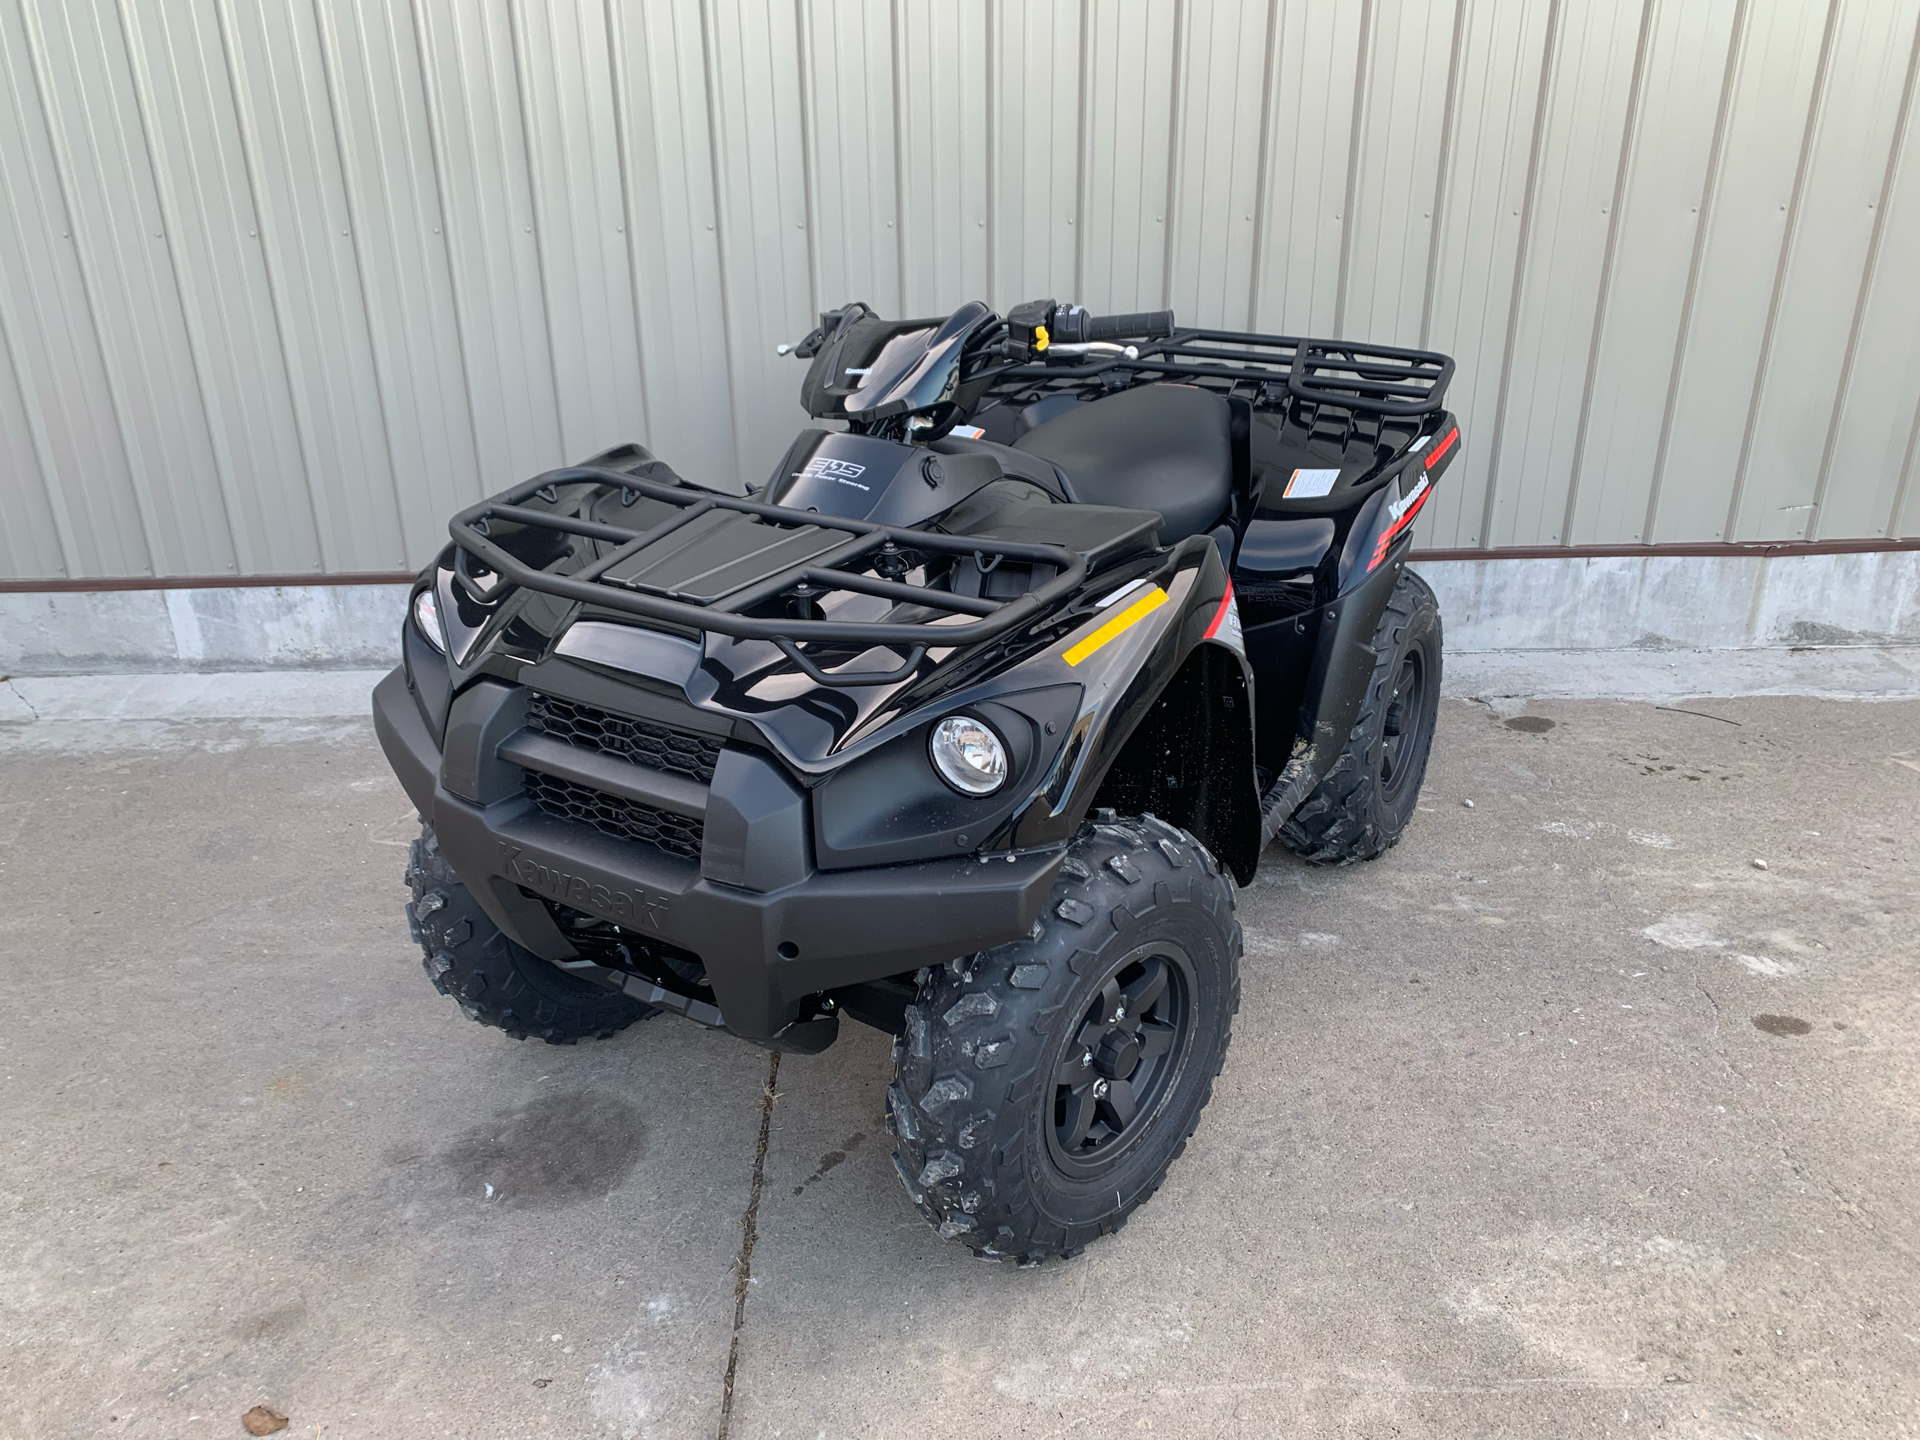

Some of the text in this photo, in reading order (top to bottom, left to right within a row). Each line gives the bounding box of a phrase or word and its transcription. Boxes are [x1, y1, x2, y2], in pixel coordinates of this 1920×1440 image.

[805, 457, 866, 478] EPS
[838, 478, 870, 491] Steering
[1388, 471, 1429, 520] Kawasaki
[498, 840, 669, 930] Kawasaki
